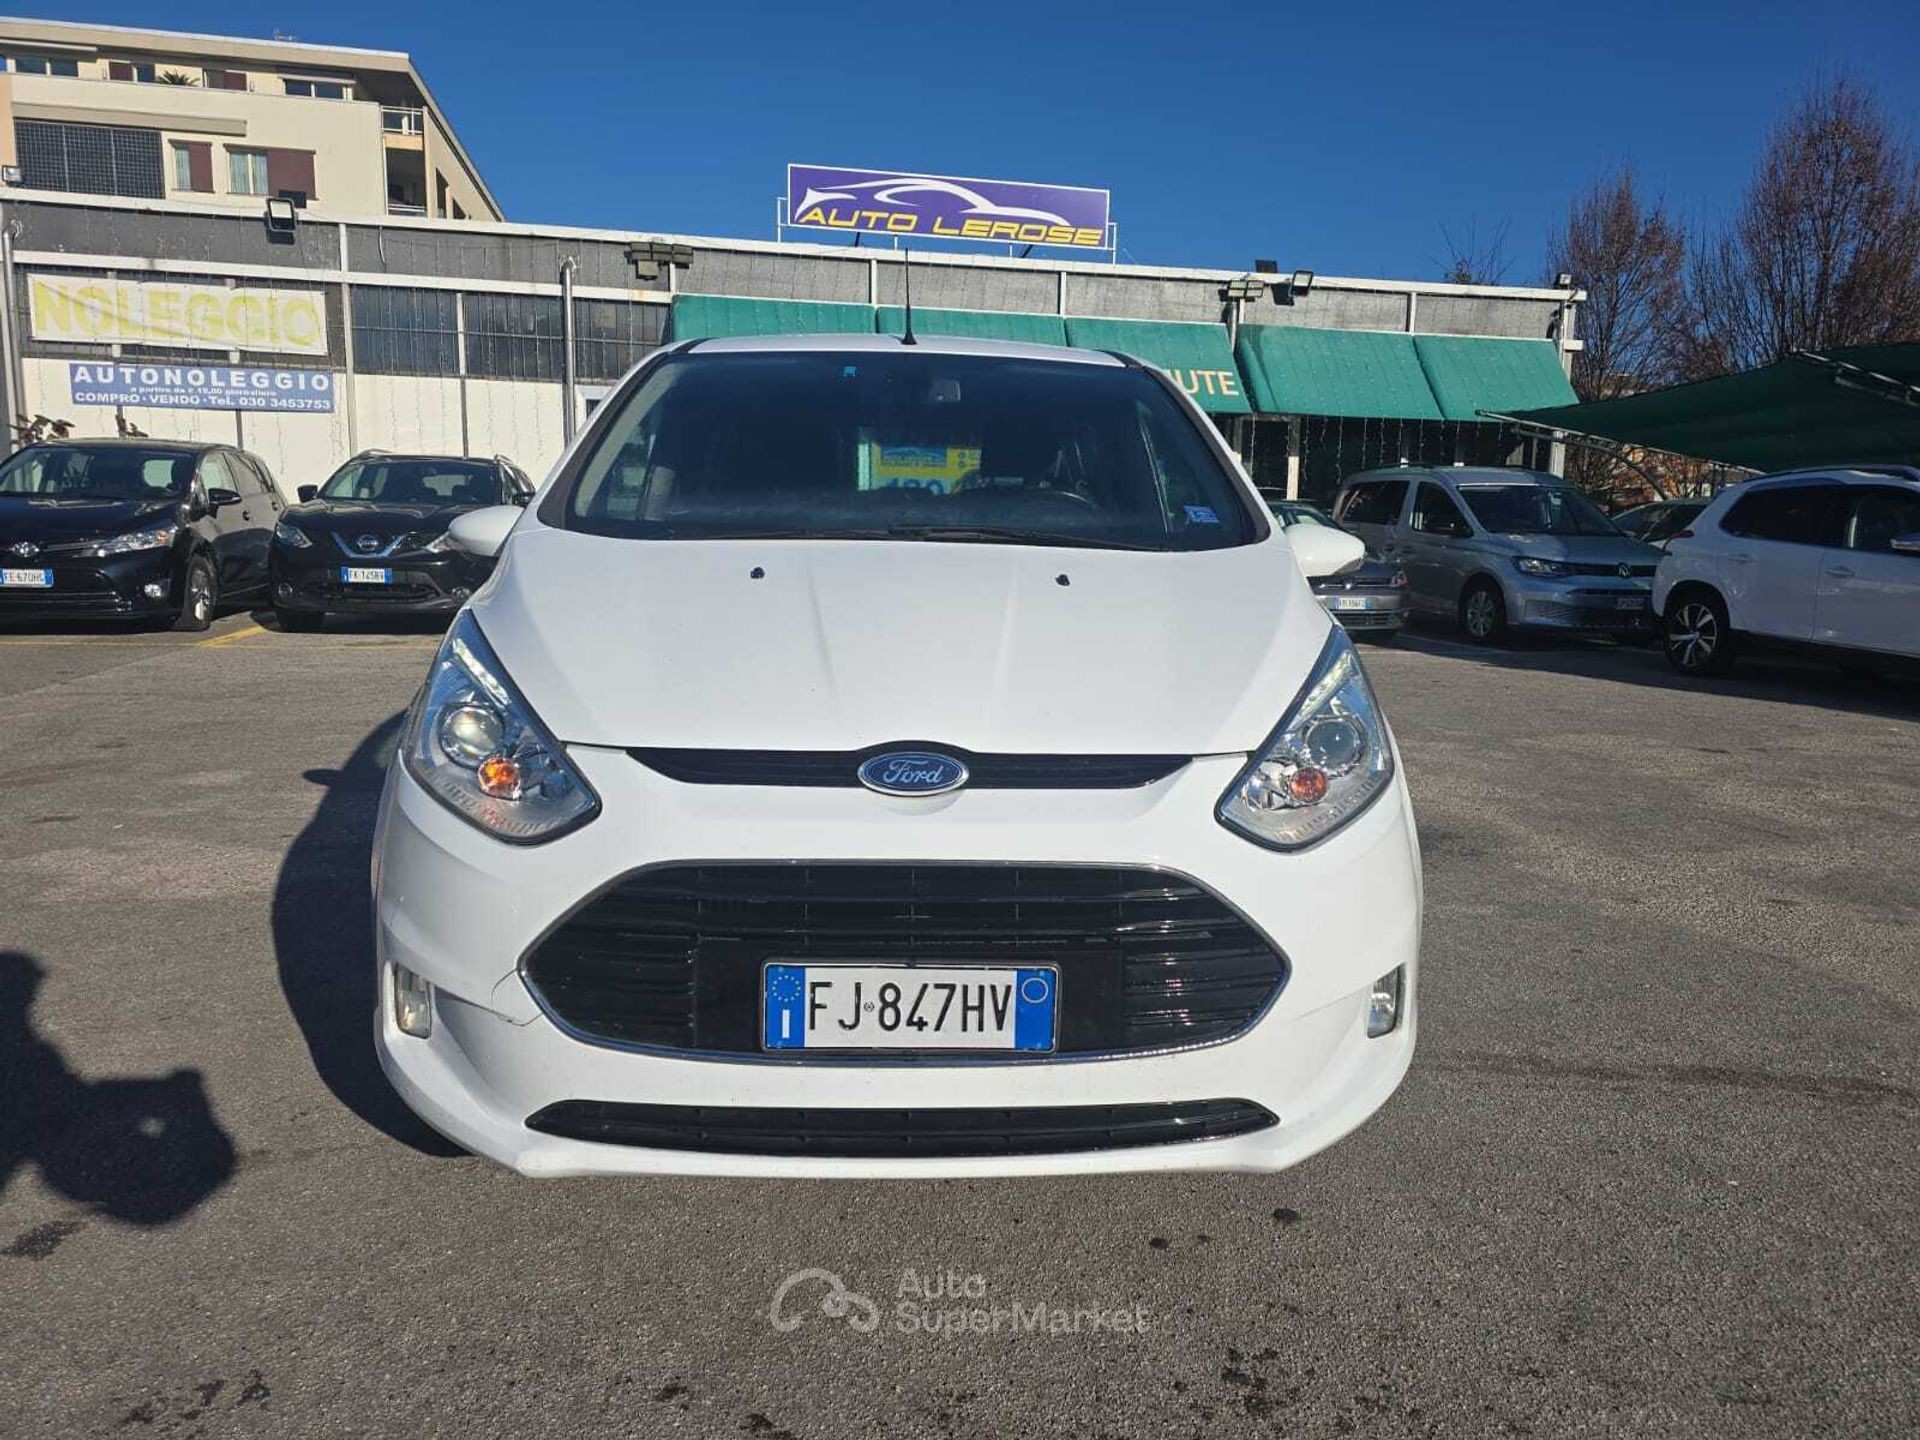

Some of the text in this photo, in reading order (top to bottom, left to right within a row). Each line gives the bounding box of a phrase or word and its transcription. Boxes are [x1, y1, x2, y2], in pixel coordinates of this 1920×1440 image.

[799, 206, 1104, 246] AUTO LEROSE
[33, 280, 321, 347] NOLEGGIO
[74, 366, 330, 391] AUTONOLEGGIO
[75, 392, 140, 404] COMPRO
[149, 394, 201, 405] VENDO
[208, 395, 235, 406] Tel.
[239, 397, 266, 408] 030
[882, 759, 945, 784] Ford
